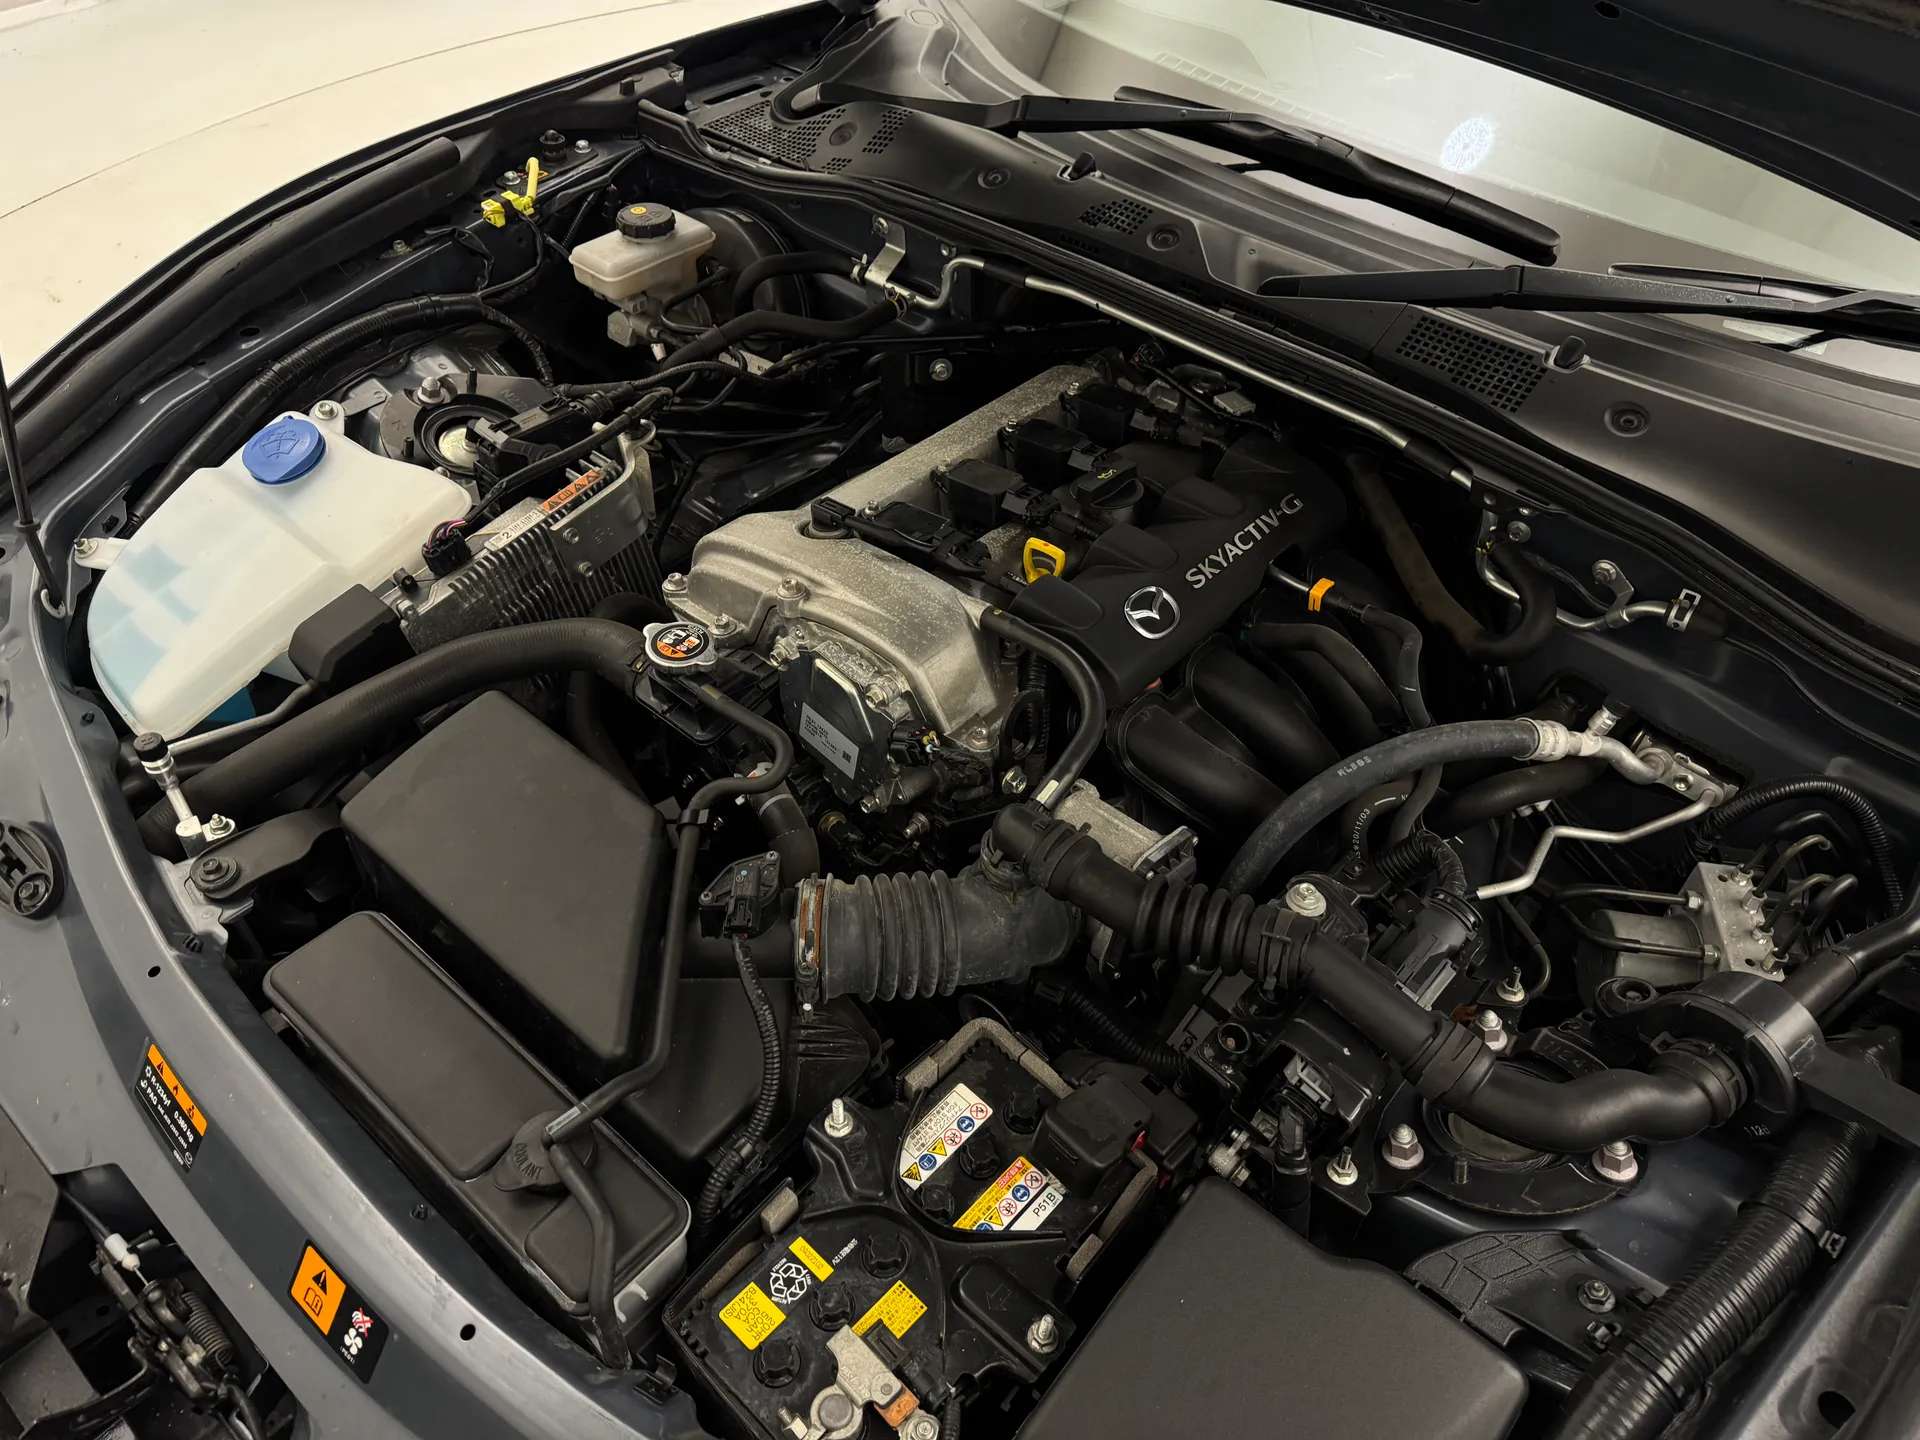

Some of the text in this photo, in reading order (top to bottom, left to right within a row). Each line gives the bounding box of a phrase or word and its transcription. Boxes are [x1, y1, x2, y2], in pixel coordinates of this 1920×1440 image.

[1185, 493, 1304, 589] SKYACTIV-G
[146, 1086, 157, 1105] PAG
[514, 1142, 544, 1180] COOLANT
[1033, 1192, 1055, 1216] P51B
[741, 1305, 761, 1325] CCA
[751, 1316, 776, 1341] 20HR
